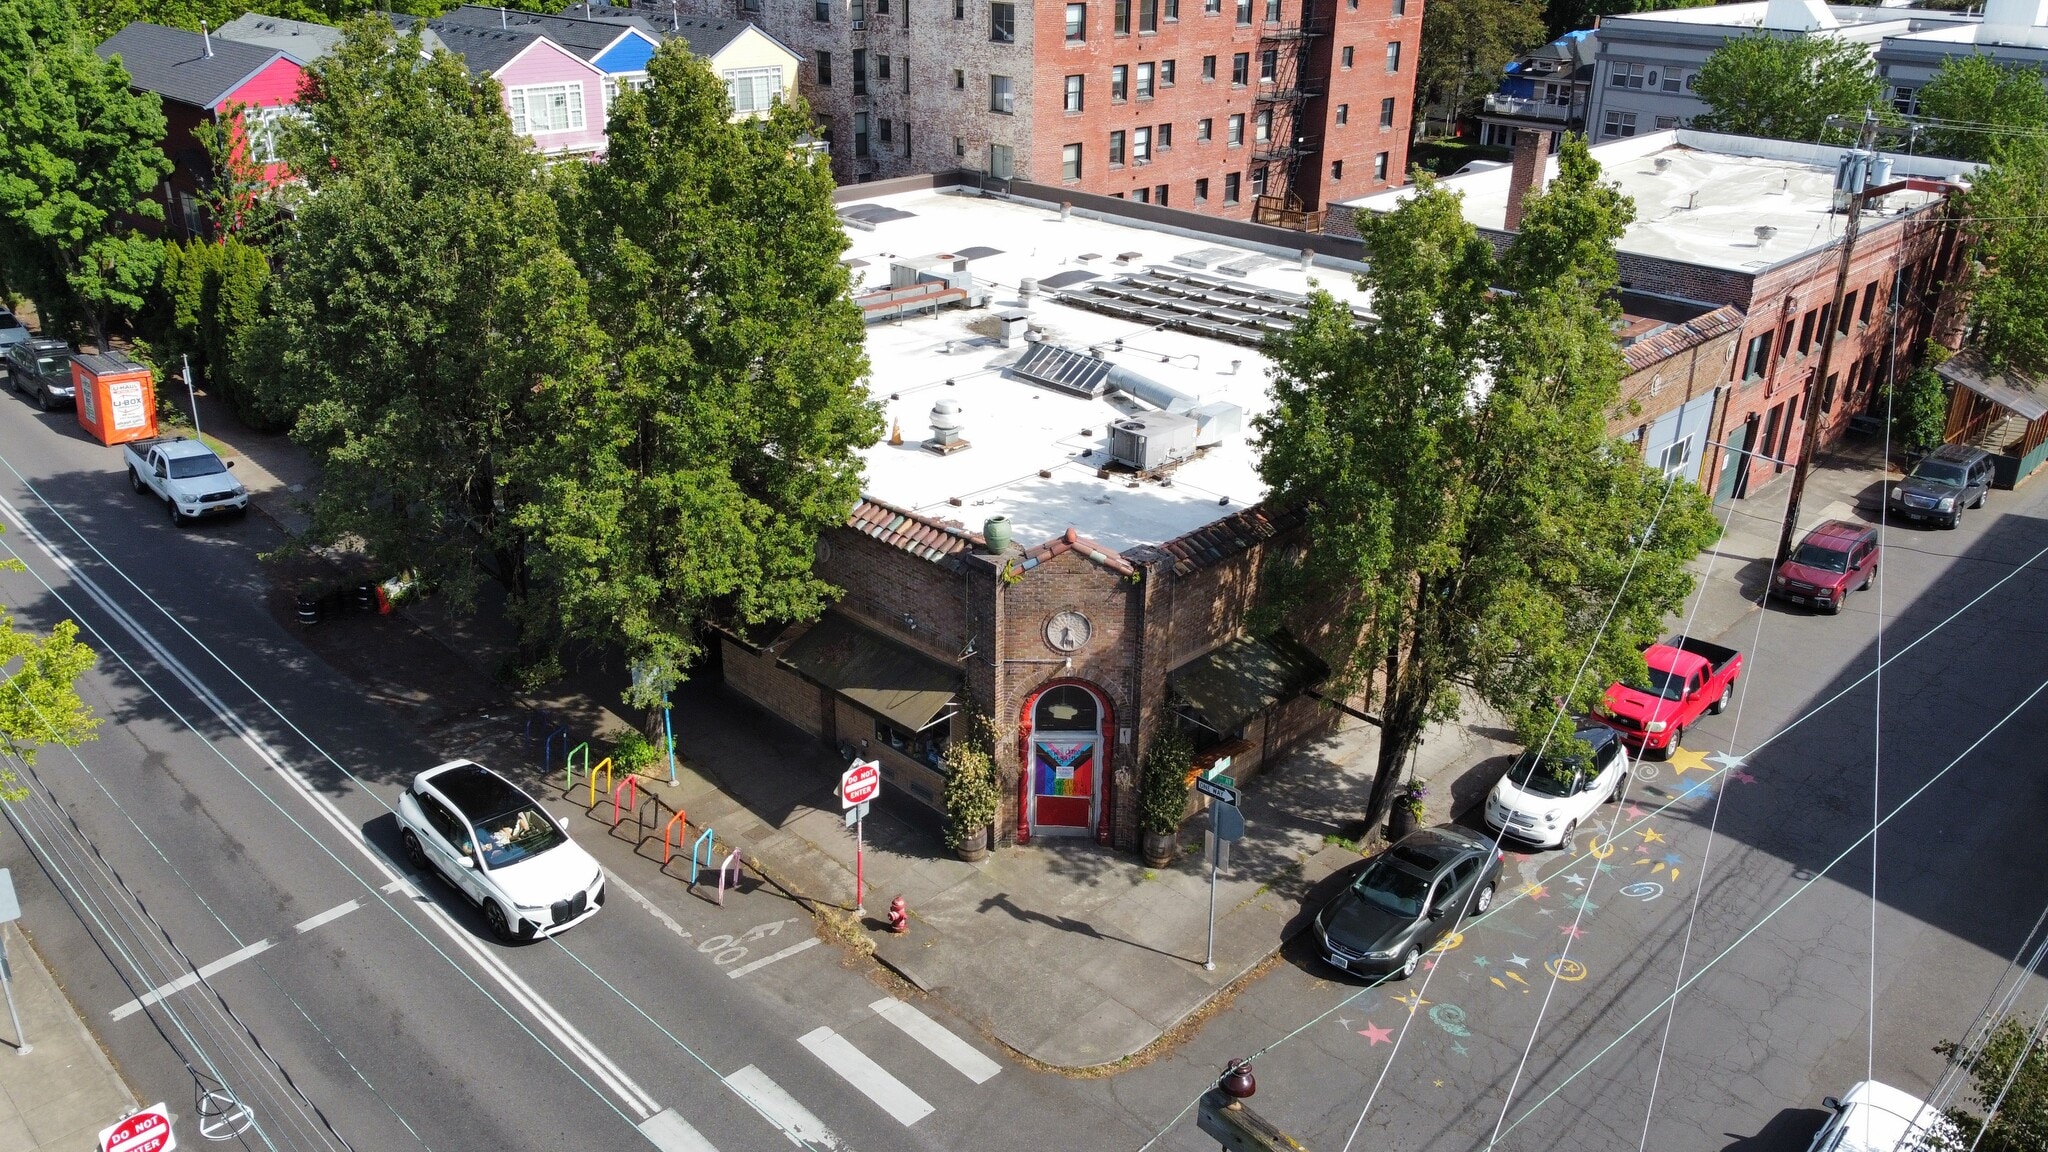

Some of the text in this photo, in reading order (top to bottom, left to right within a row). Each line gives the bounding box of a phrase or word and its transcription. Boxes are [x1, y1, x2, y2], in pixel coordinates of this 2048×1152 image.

[113, 398, 142, 407] U-BOX
[848, 769, 873, 784] DO NOT
[850, 786, 871, 799] ENTER
[1199, 782, 1224, 797] ONE WAY
[112, 1116, 158, 1144] DO NOT
